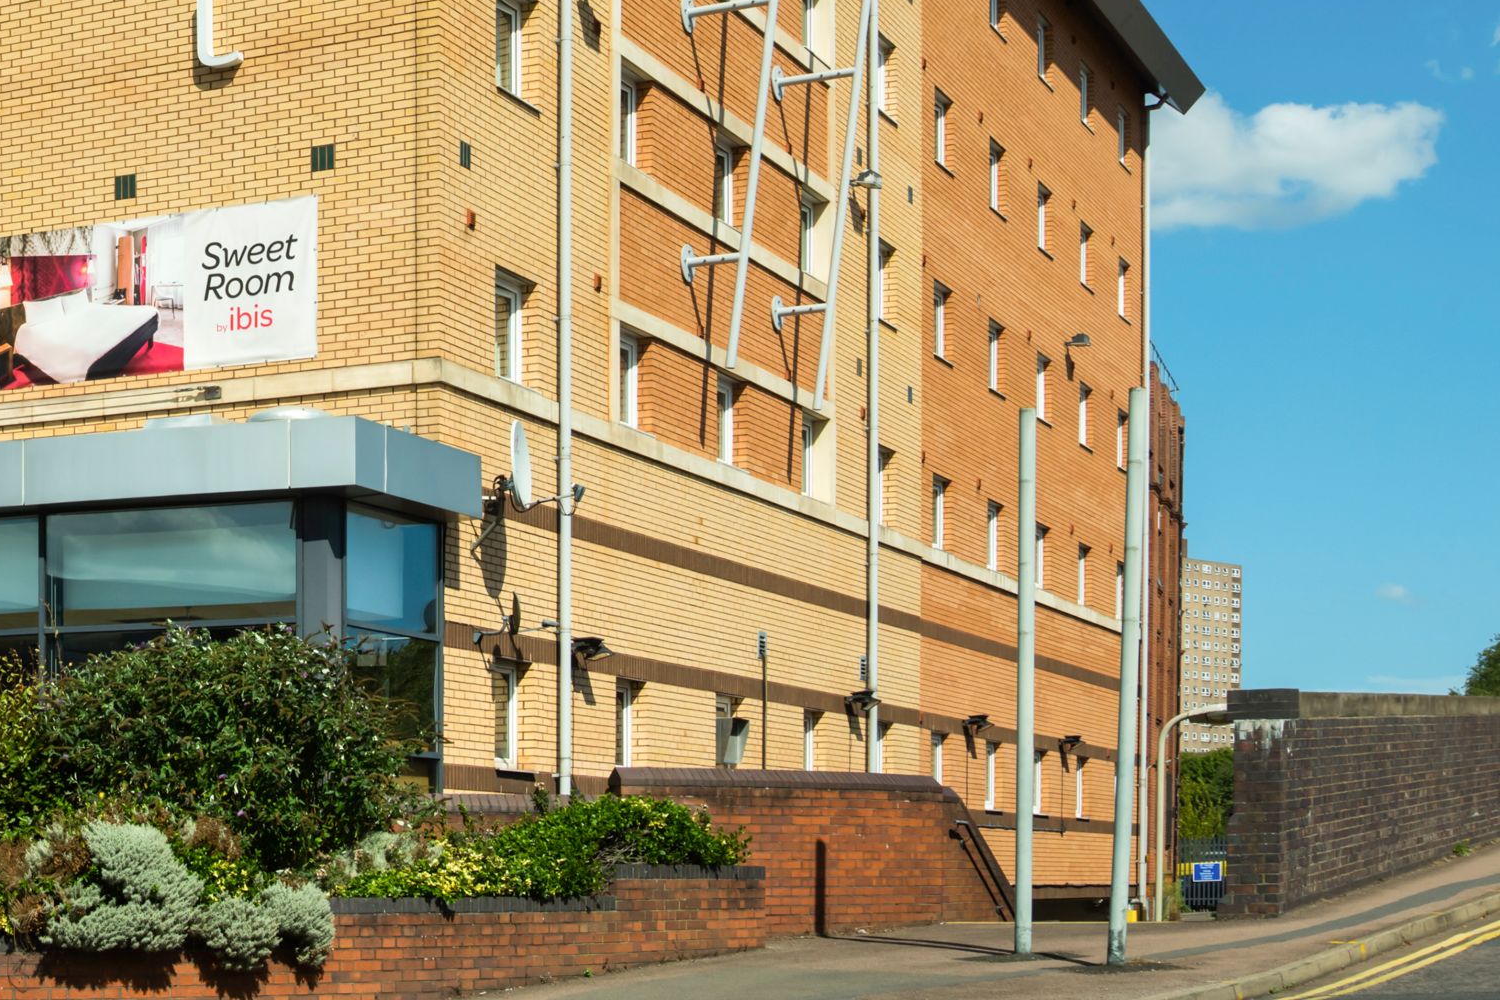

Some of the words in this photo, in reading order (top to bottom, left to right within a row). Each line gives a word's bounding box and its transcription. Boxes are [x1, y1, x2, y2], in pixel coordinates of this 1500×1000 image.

[201, 233, 298, 270] Sweet
[203, 270, 295, 301] Room
[216, 323, 228, 333] by
[229, 303, 274, 332] ibis
